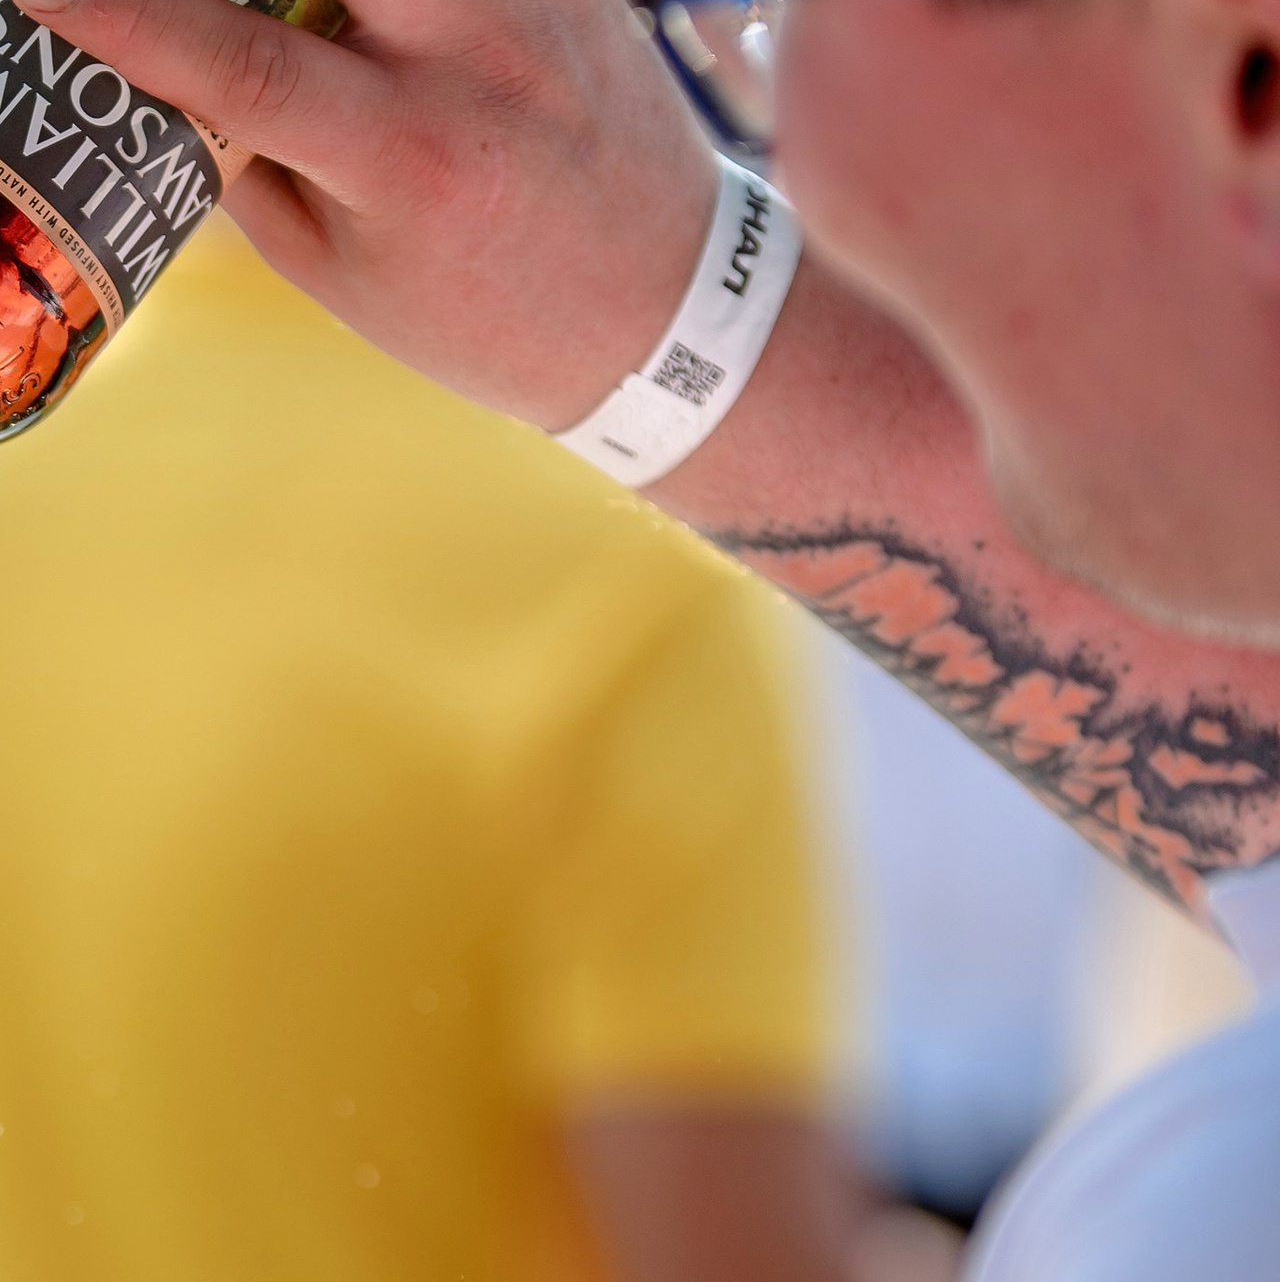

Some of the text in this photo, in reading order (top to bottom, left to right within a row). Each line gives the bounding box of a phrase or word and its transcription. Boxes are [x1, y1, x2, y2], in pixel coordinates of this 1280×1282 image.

[28, 195, 58, 228] WITH
[59, 227, 99, 275] INFUSED
[94, 275, 118, 310] WHISKY
